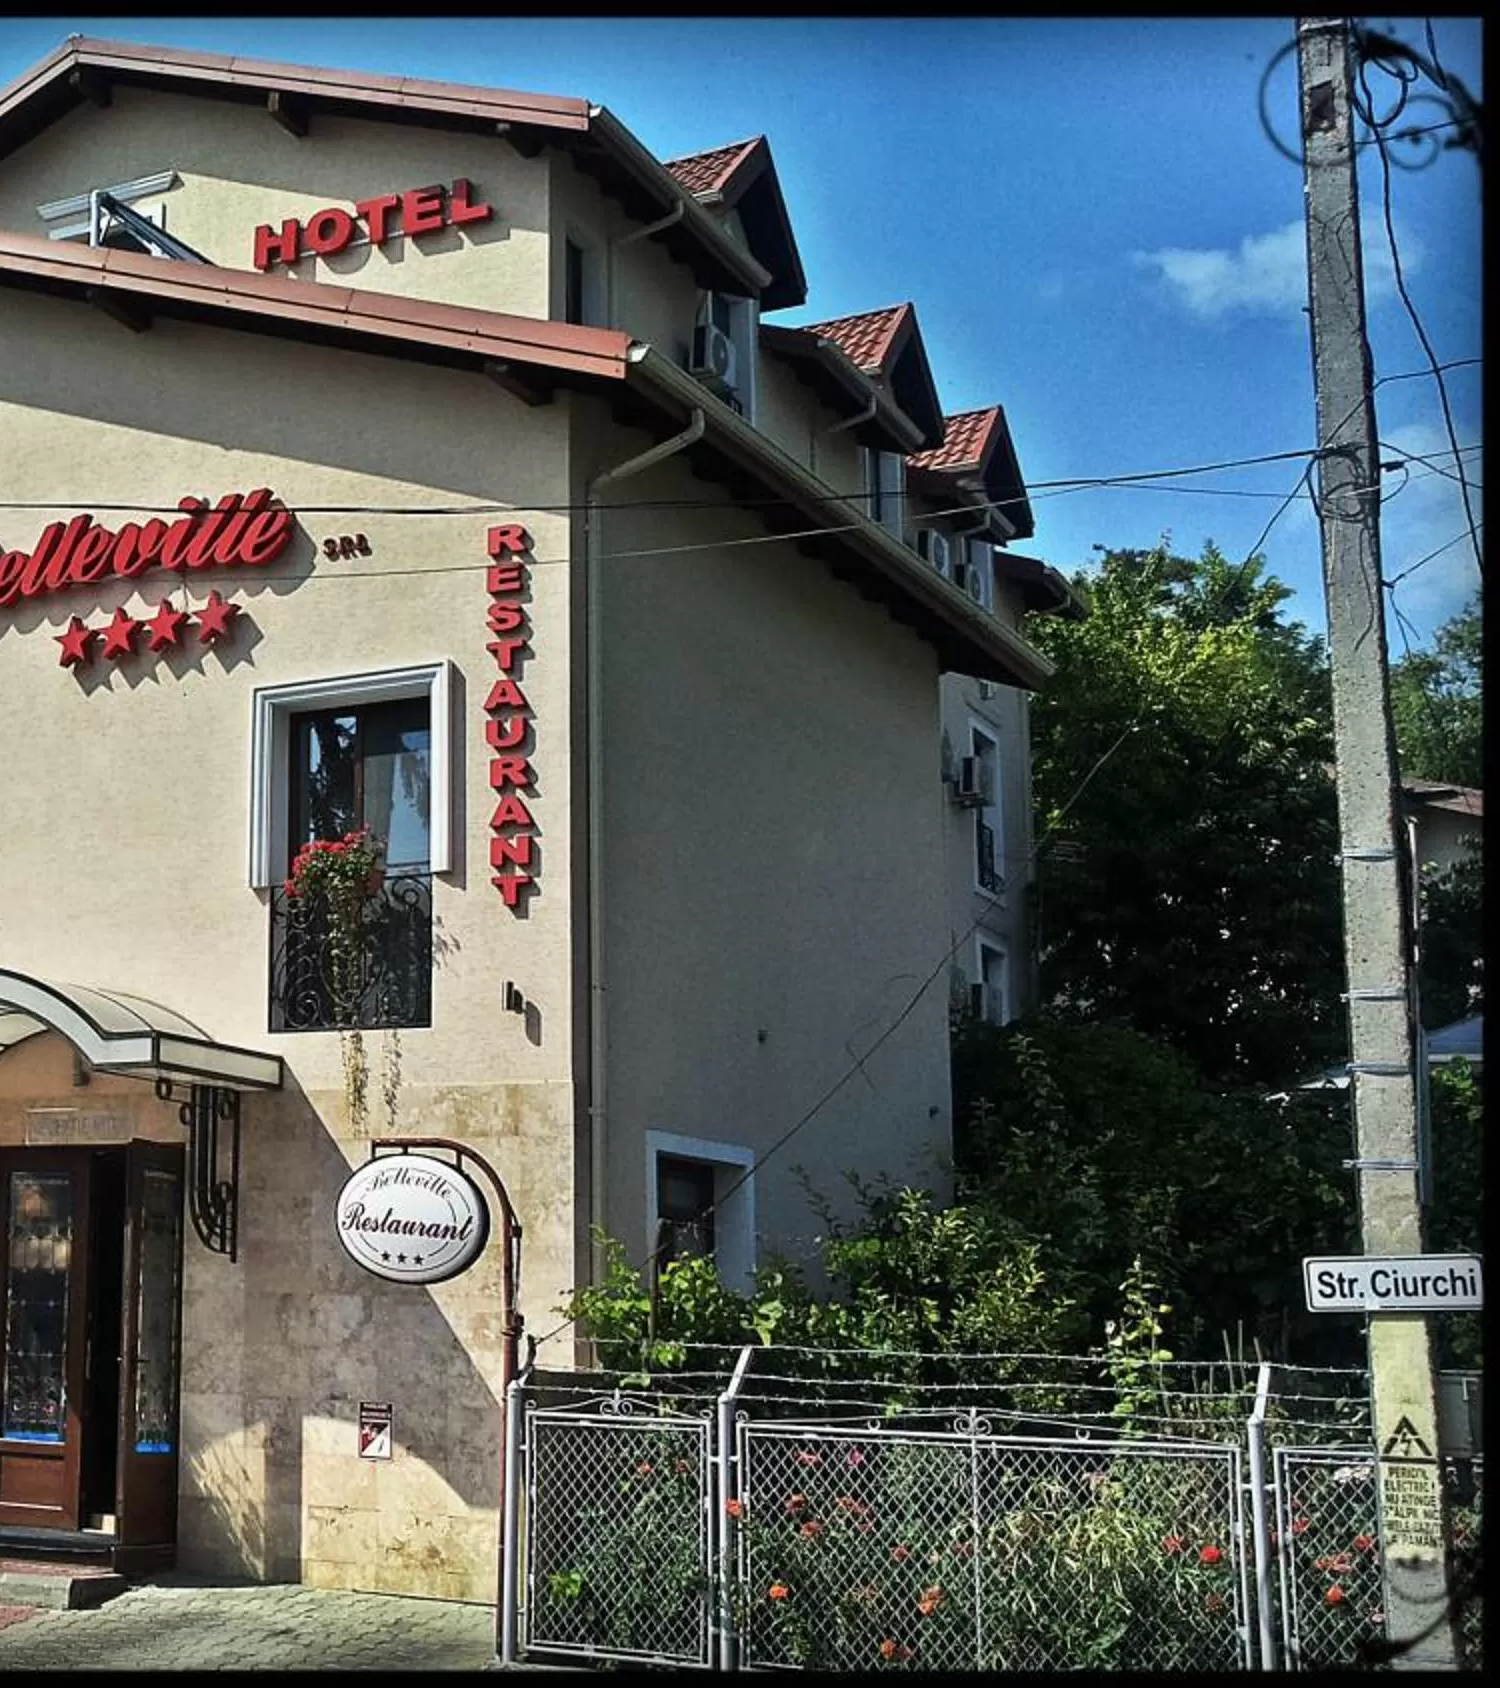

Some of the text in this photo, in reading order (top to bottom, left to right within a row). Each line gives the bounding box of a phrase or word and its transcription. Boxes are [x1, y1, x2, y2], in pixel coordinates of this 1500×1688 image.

[254, 178, 493, 270] HOTEL
[483, 523, 533, 907] RESTAURANT
[366, 1167, 452, 1199] Belleville
[342, 1201, 474, 1242] Restaurant
[1317, 1267, 1477, 1299] Str. Ciurchi
